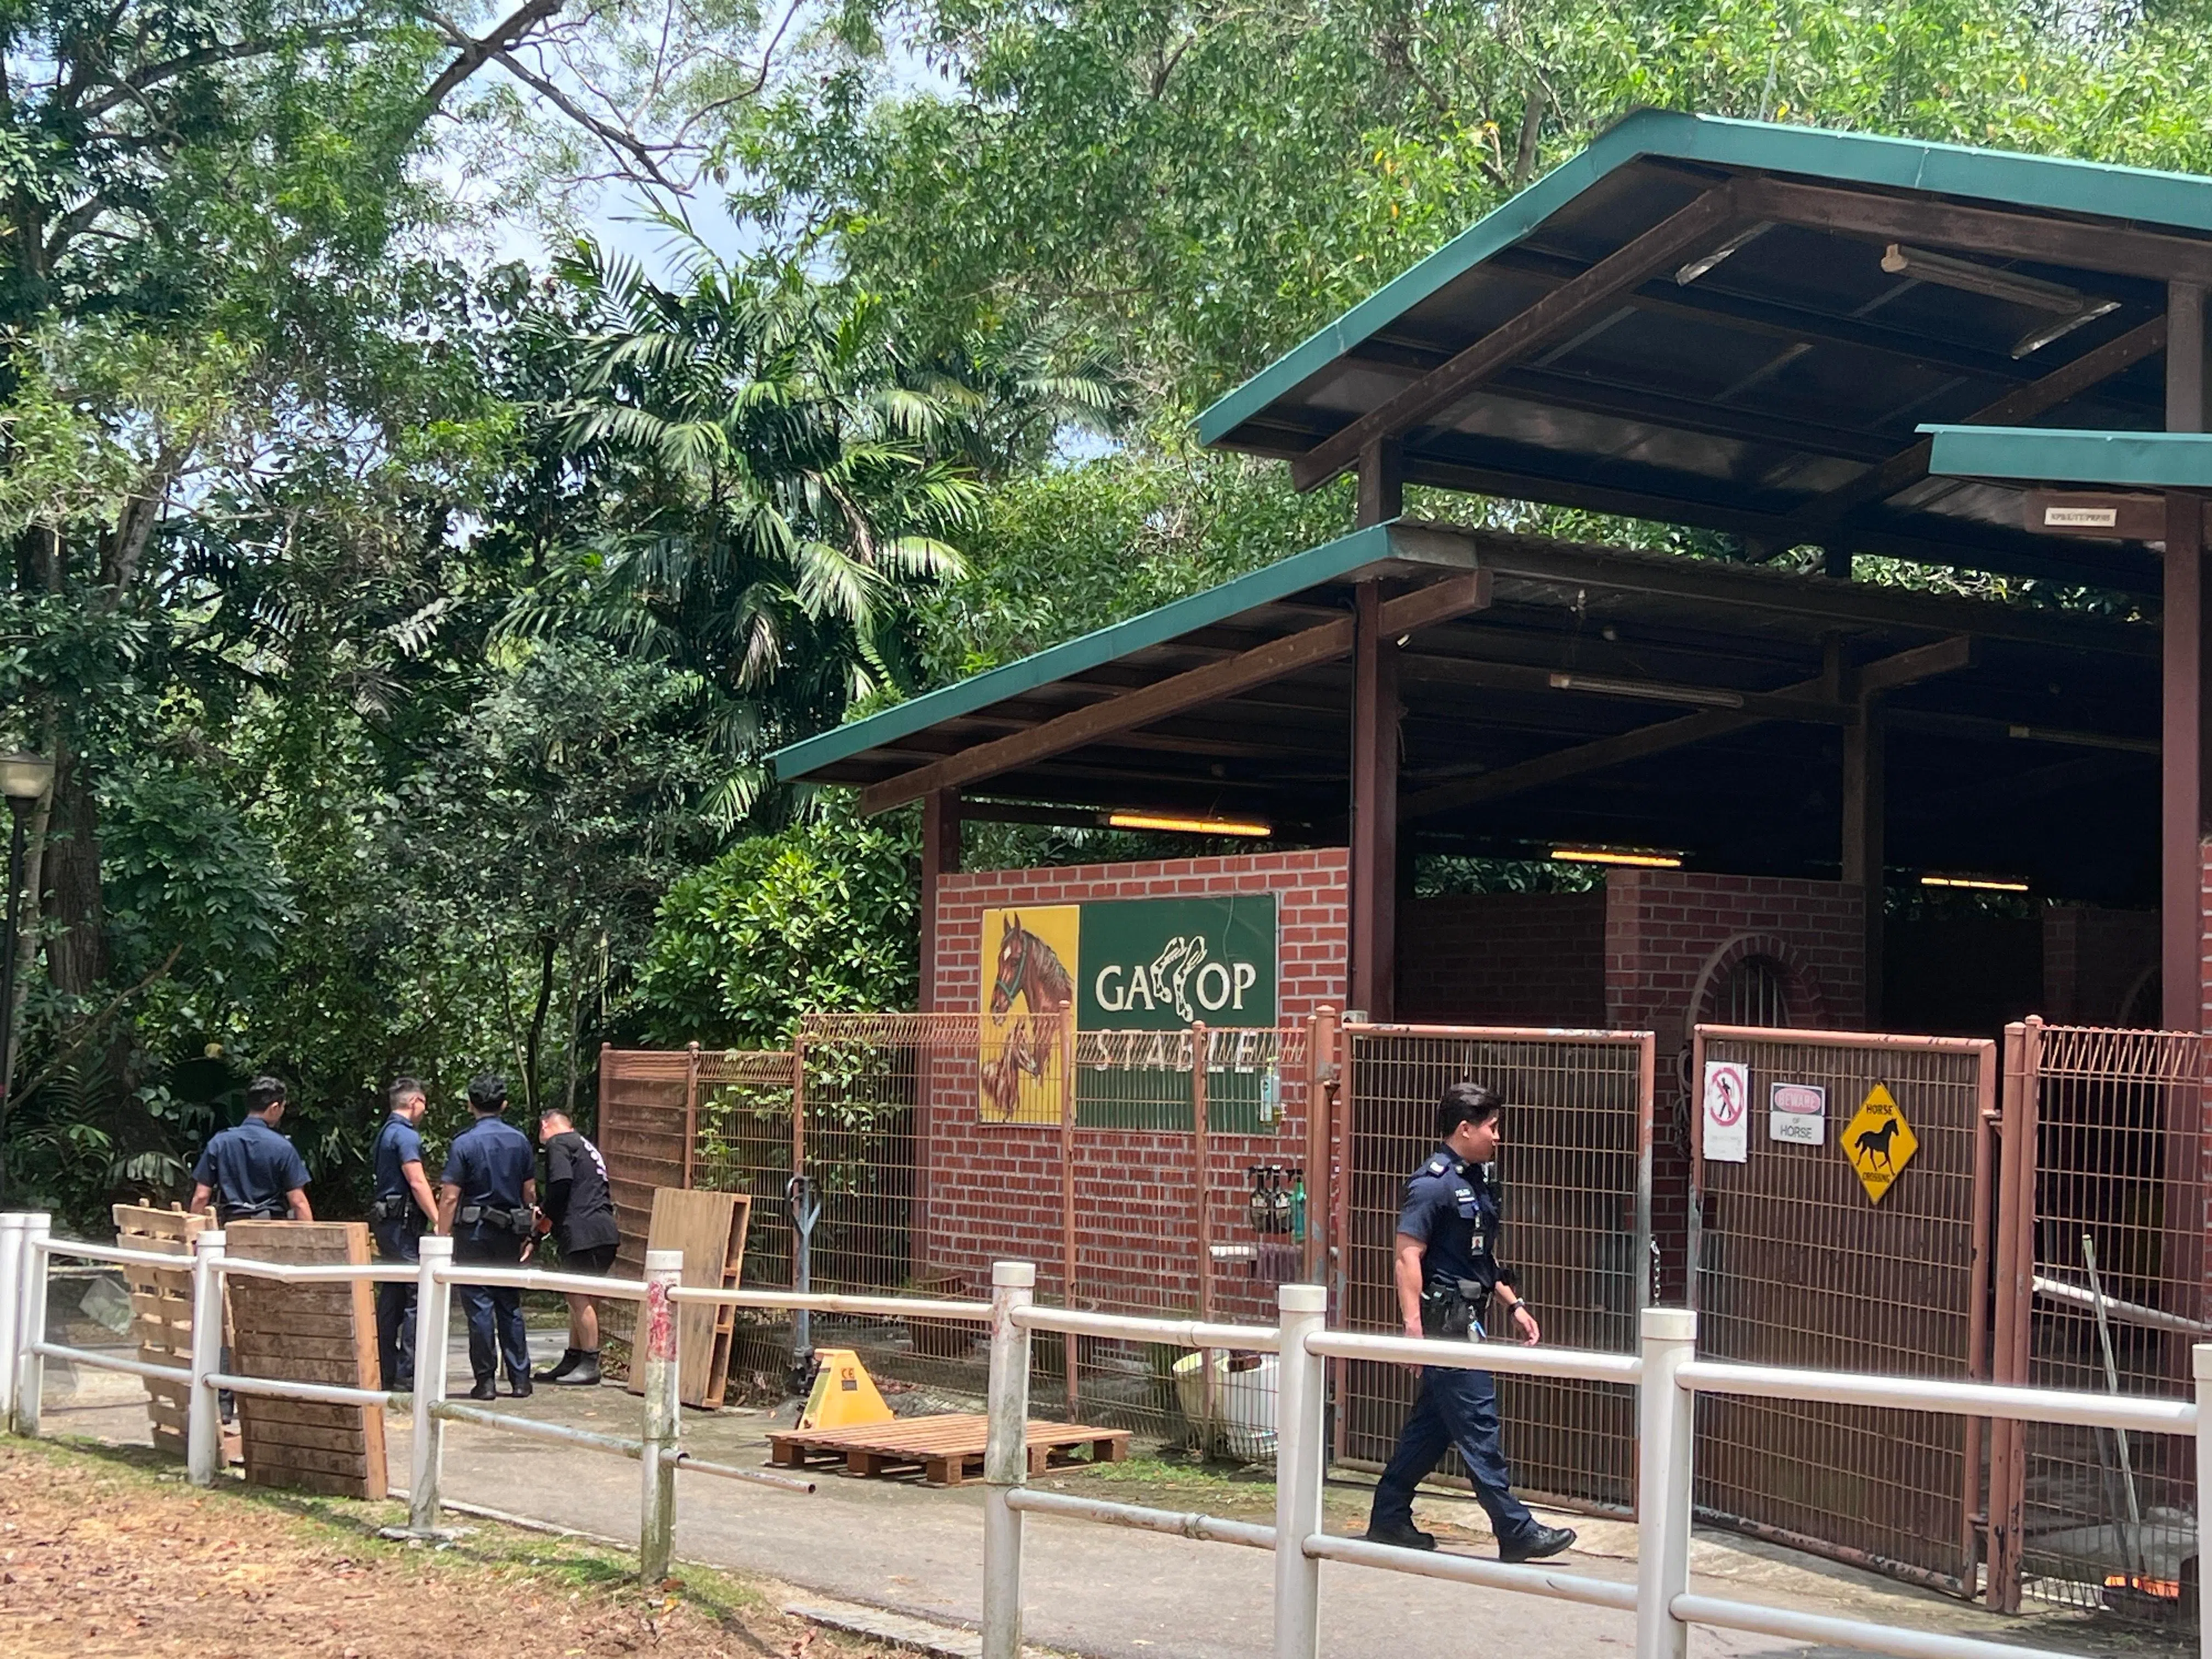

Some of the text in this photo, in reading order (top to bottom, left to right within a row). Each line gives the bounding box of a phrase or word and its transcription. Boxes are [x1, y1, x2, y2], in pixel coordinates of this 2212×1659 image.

[1094, 1028, 1256, 1073] STABLE
[1779, 1093, 1816, 1109] BEWARE
[1866, 1103, 1893, 1115] HORSE
[1780, 1125, 1812, 1139] HORSE
